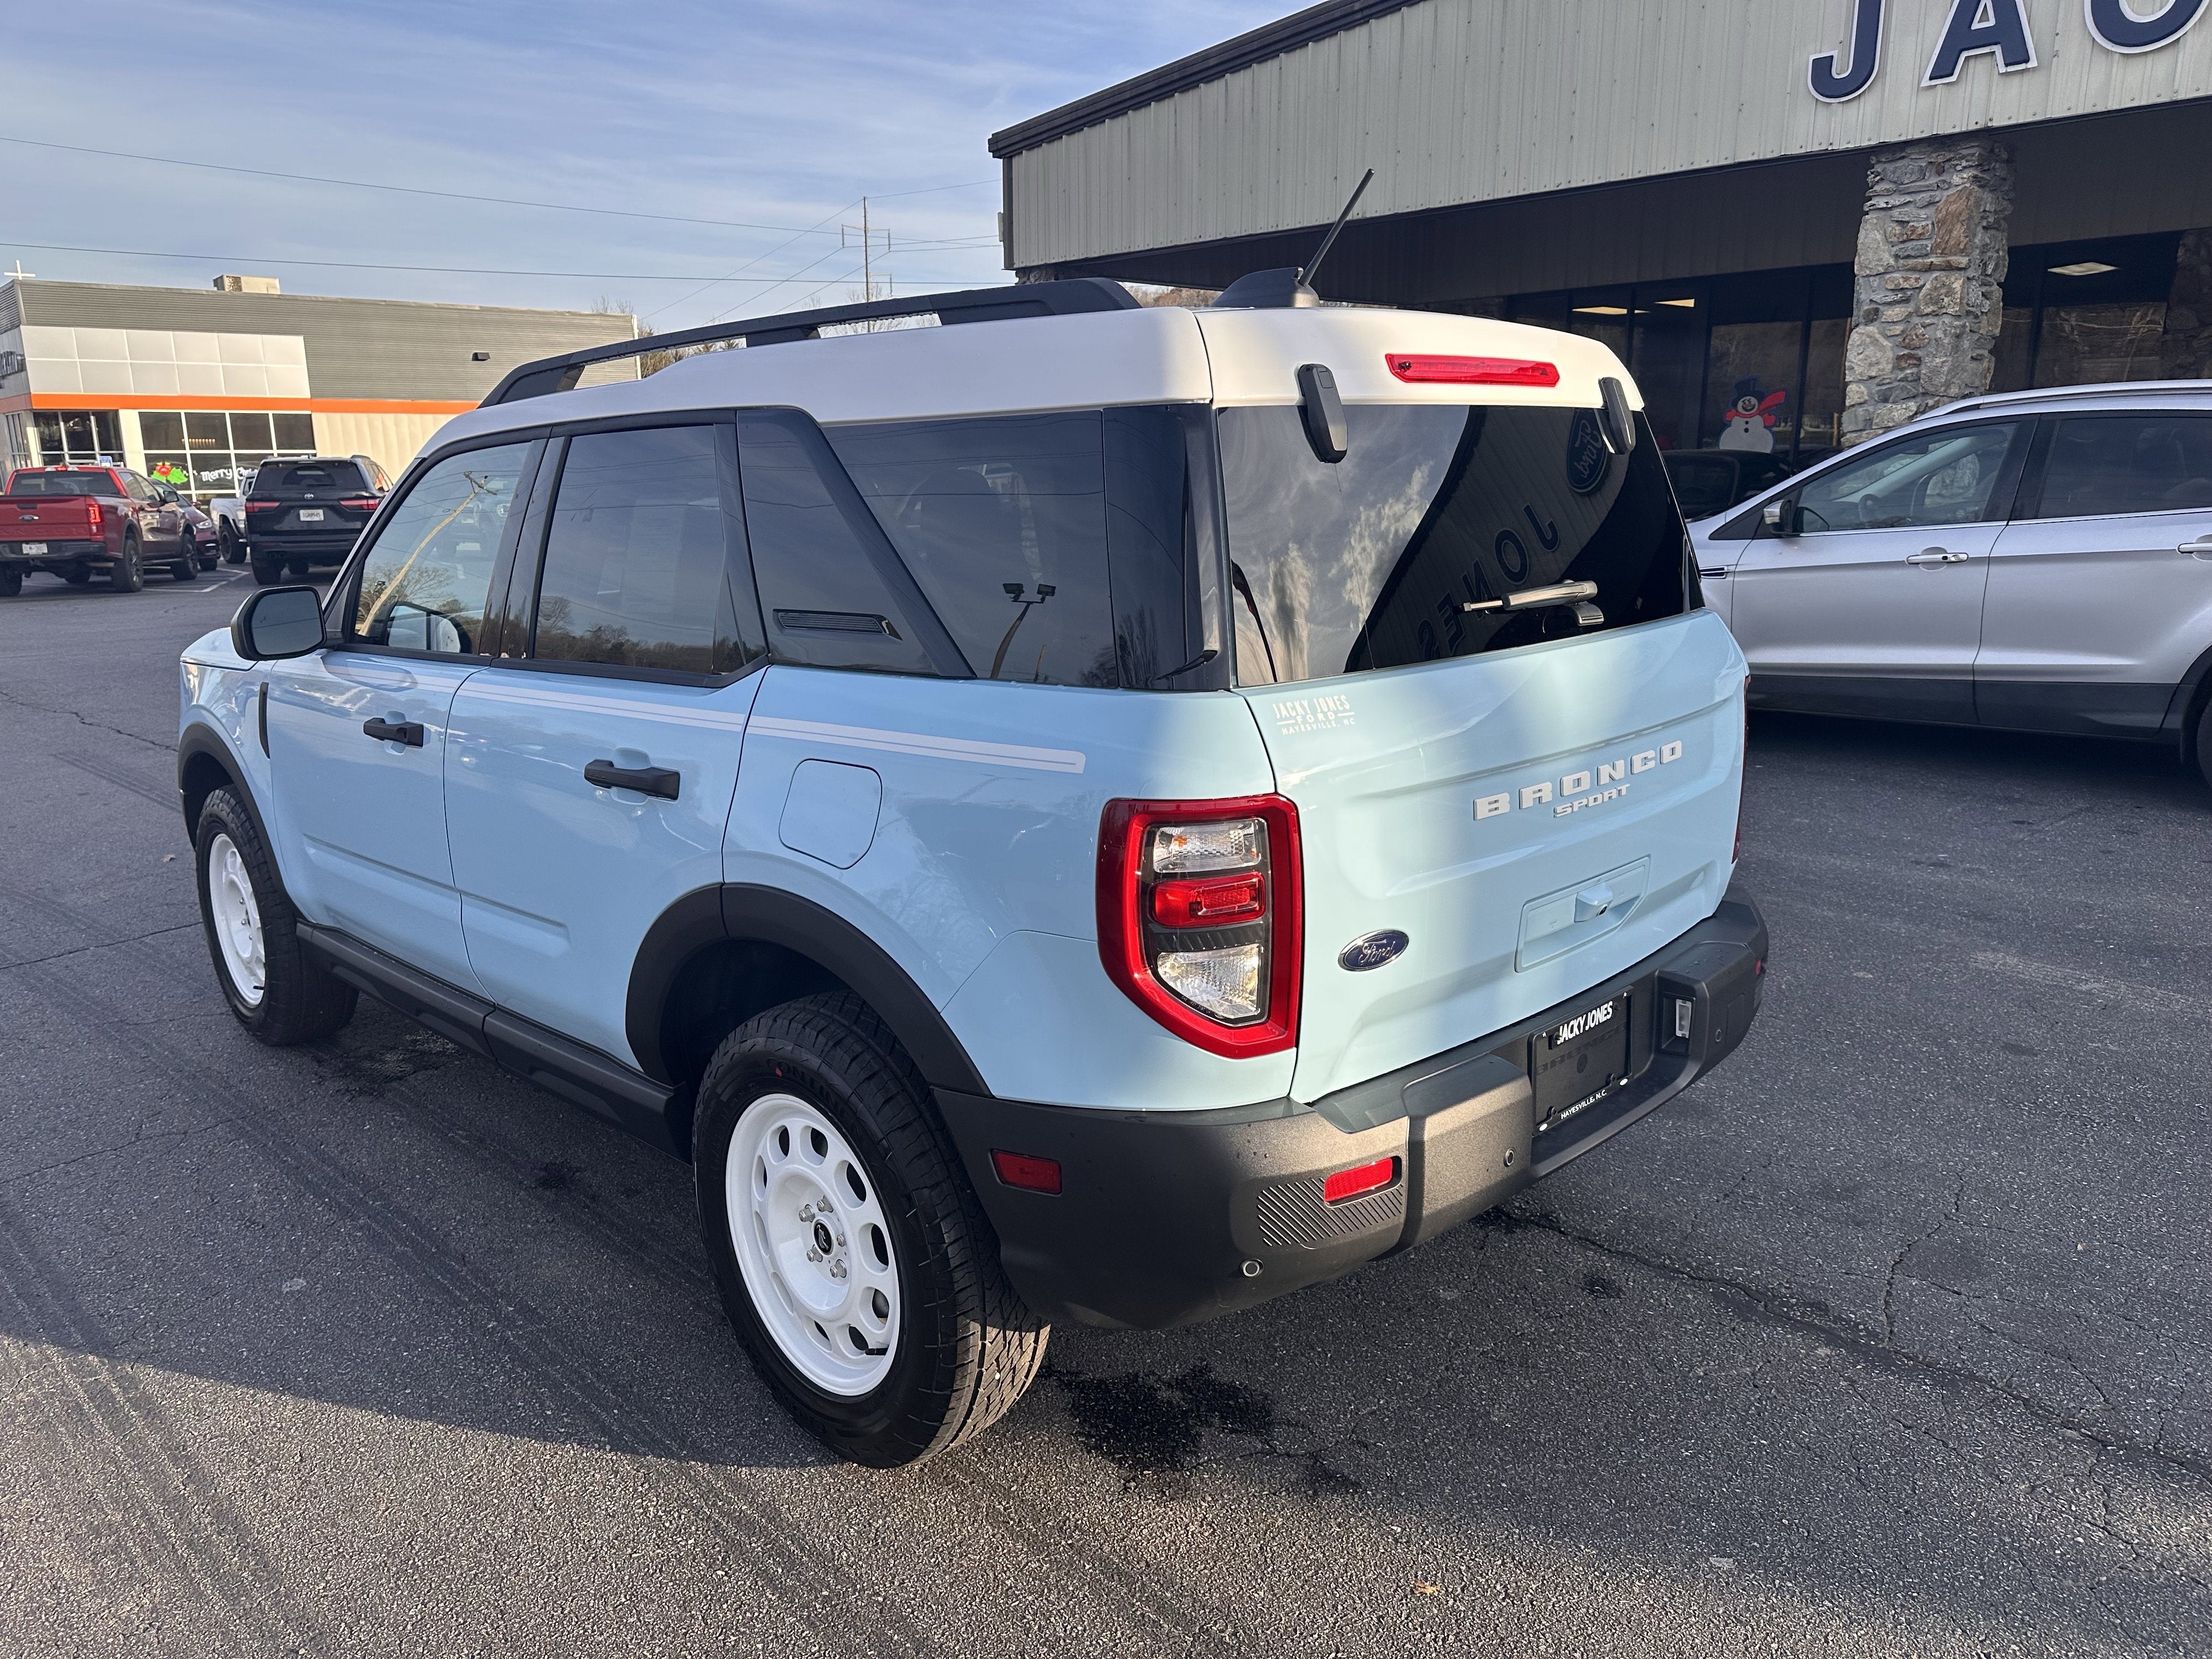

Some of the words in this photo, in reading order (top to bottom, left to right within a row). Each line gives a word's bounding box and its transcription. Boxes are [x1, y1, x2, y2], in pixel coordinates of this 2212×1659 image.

[1273, 699, 1312, 719] JACKY
[1313, 695, 1350, 713] JONES
[1296, 712, 1335, 724] FORD
[1282, 721, 1340, 735] HAYESVILLE,
[1473, 740, 1683, 821] BRONCO
[1553, 783, 1630, 817] SPORT
[1358, 939, 1396, 966] Ford
[1557, 1014, 1587, 1045] JACKY
[1585, 1001, 1613, 1031] JONES
[1595, 1090, 1607, 1100] N.C.
